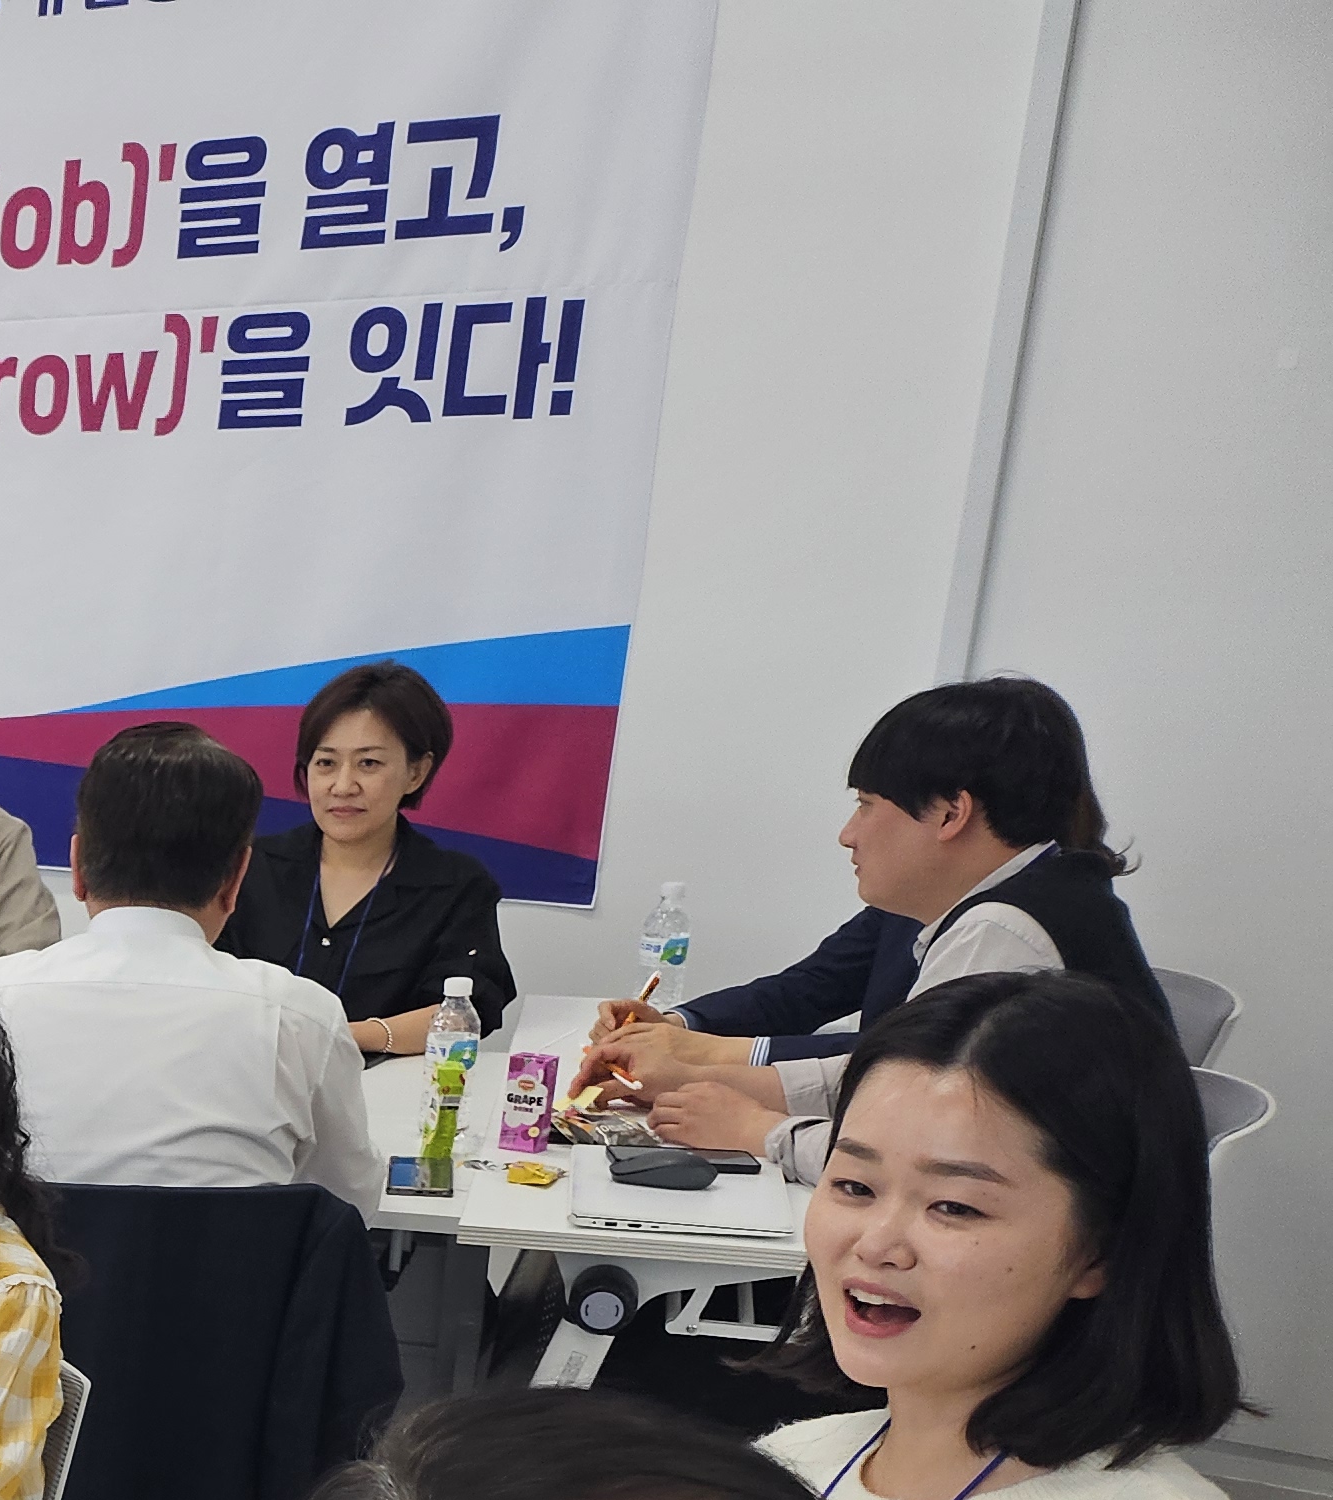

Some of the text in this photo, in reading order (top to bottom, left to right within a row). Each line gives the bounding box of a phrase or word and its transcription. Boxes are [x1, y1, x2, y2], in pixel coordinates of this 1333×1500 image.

[300, 114, 525, 252] 열고,
[344, 296, 586, 427] 잇다!
[506, 1092, 545, 1107] GRAPE
